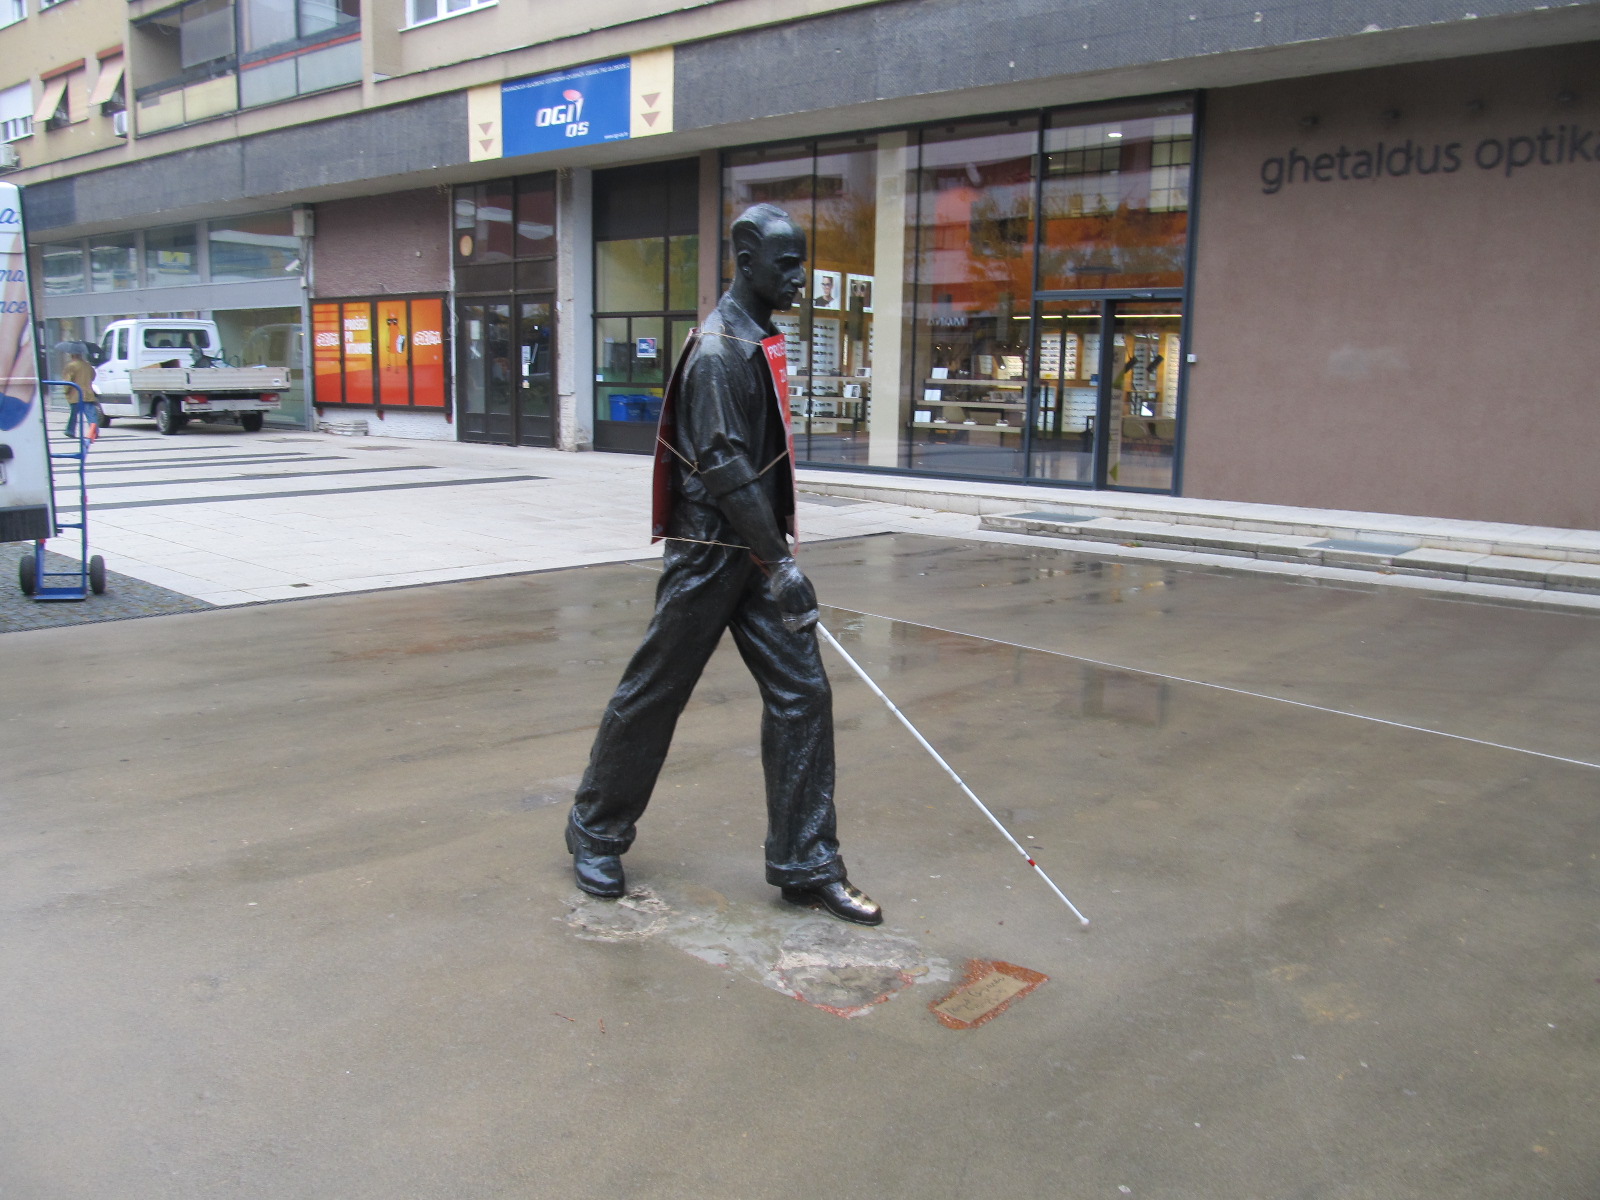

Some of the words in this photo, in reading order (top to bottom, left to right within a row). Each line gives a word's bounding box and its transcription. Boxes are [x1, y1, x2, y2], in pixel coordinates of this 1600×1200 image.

[565, 121, 590, 138] OS
[1260, 139, 1463, 195] ghetaldus
[1475, 123, 1600, 177] optik
